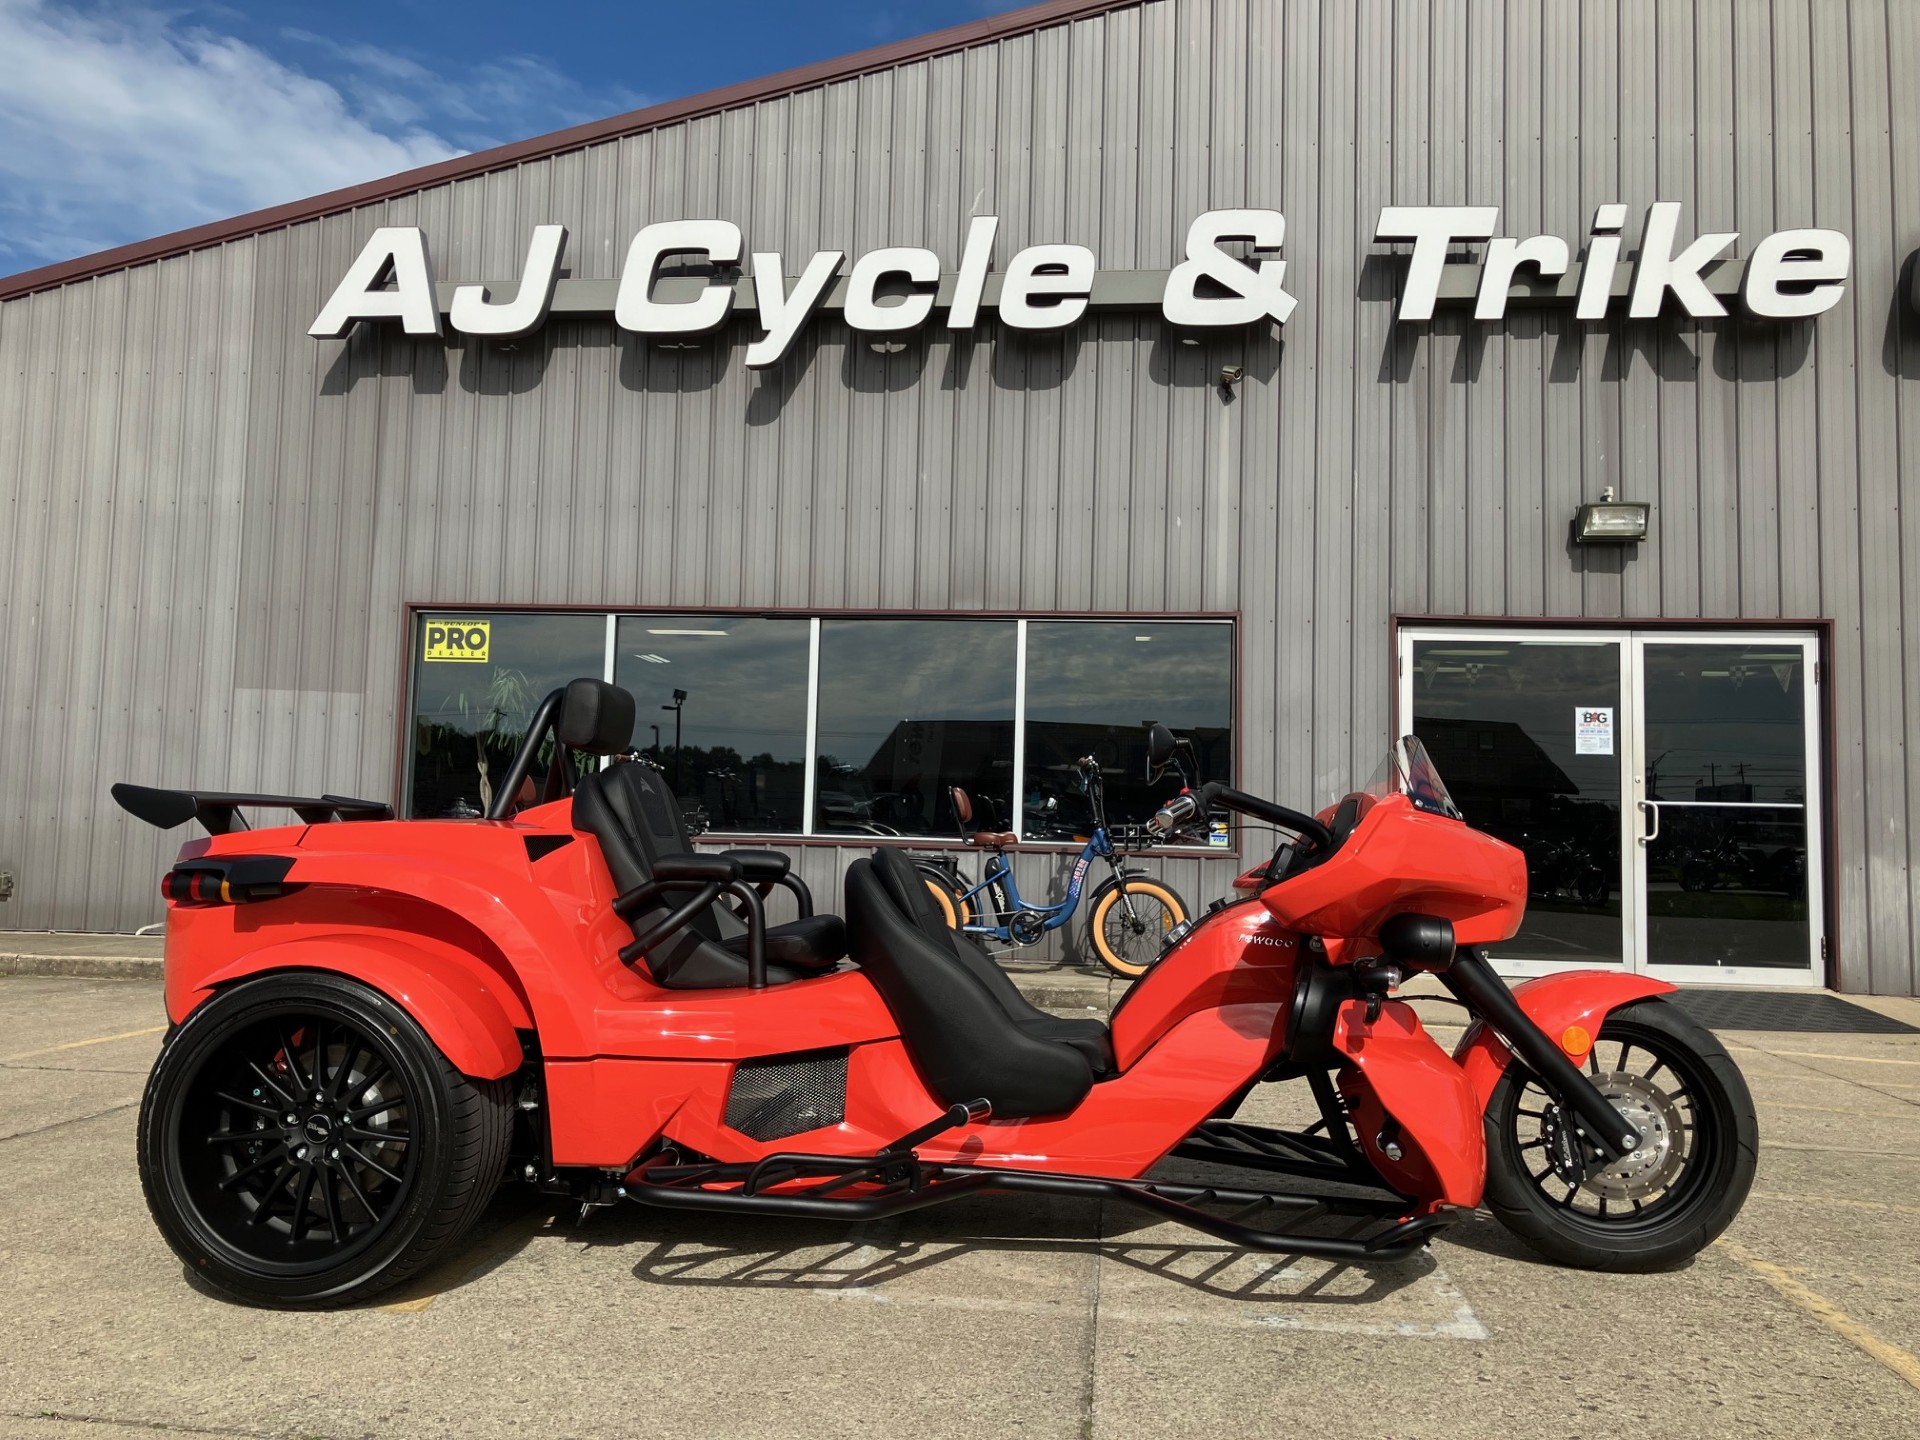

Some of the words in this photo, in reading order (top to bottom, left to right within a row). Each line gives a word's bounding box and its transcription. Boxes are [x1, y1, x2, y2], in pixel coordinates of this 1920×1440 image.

[307, 225, 567, 339] AJ
[614, 215, 1096, 369] Cycle
[1163, 208, 1298, 326] &
[1374, 202, 1850, 321] Trike
[428, 627, 487, 650] PRO
[1238, 933, 1293, 948] rewaco
